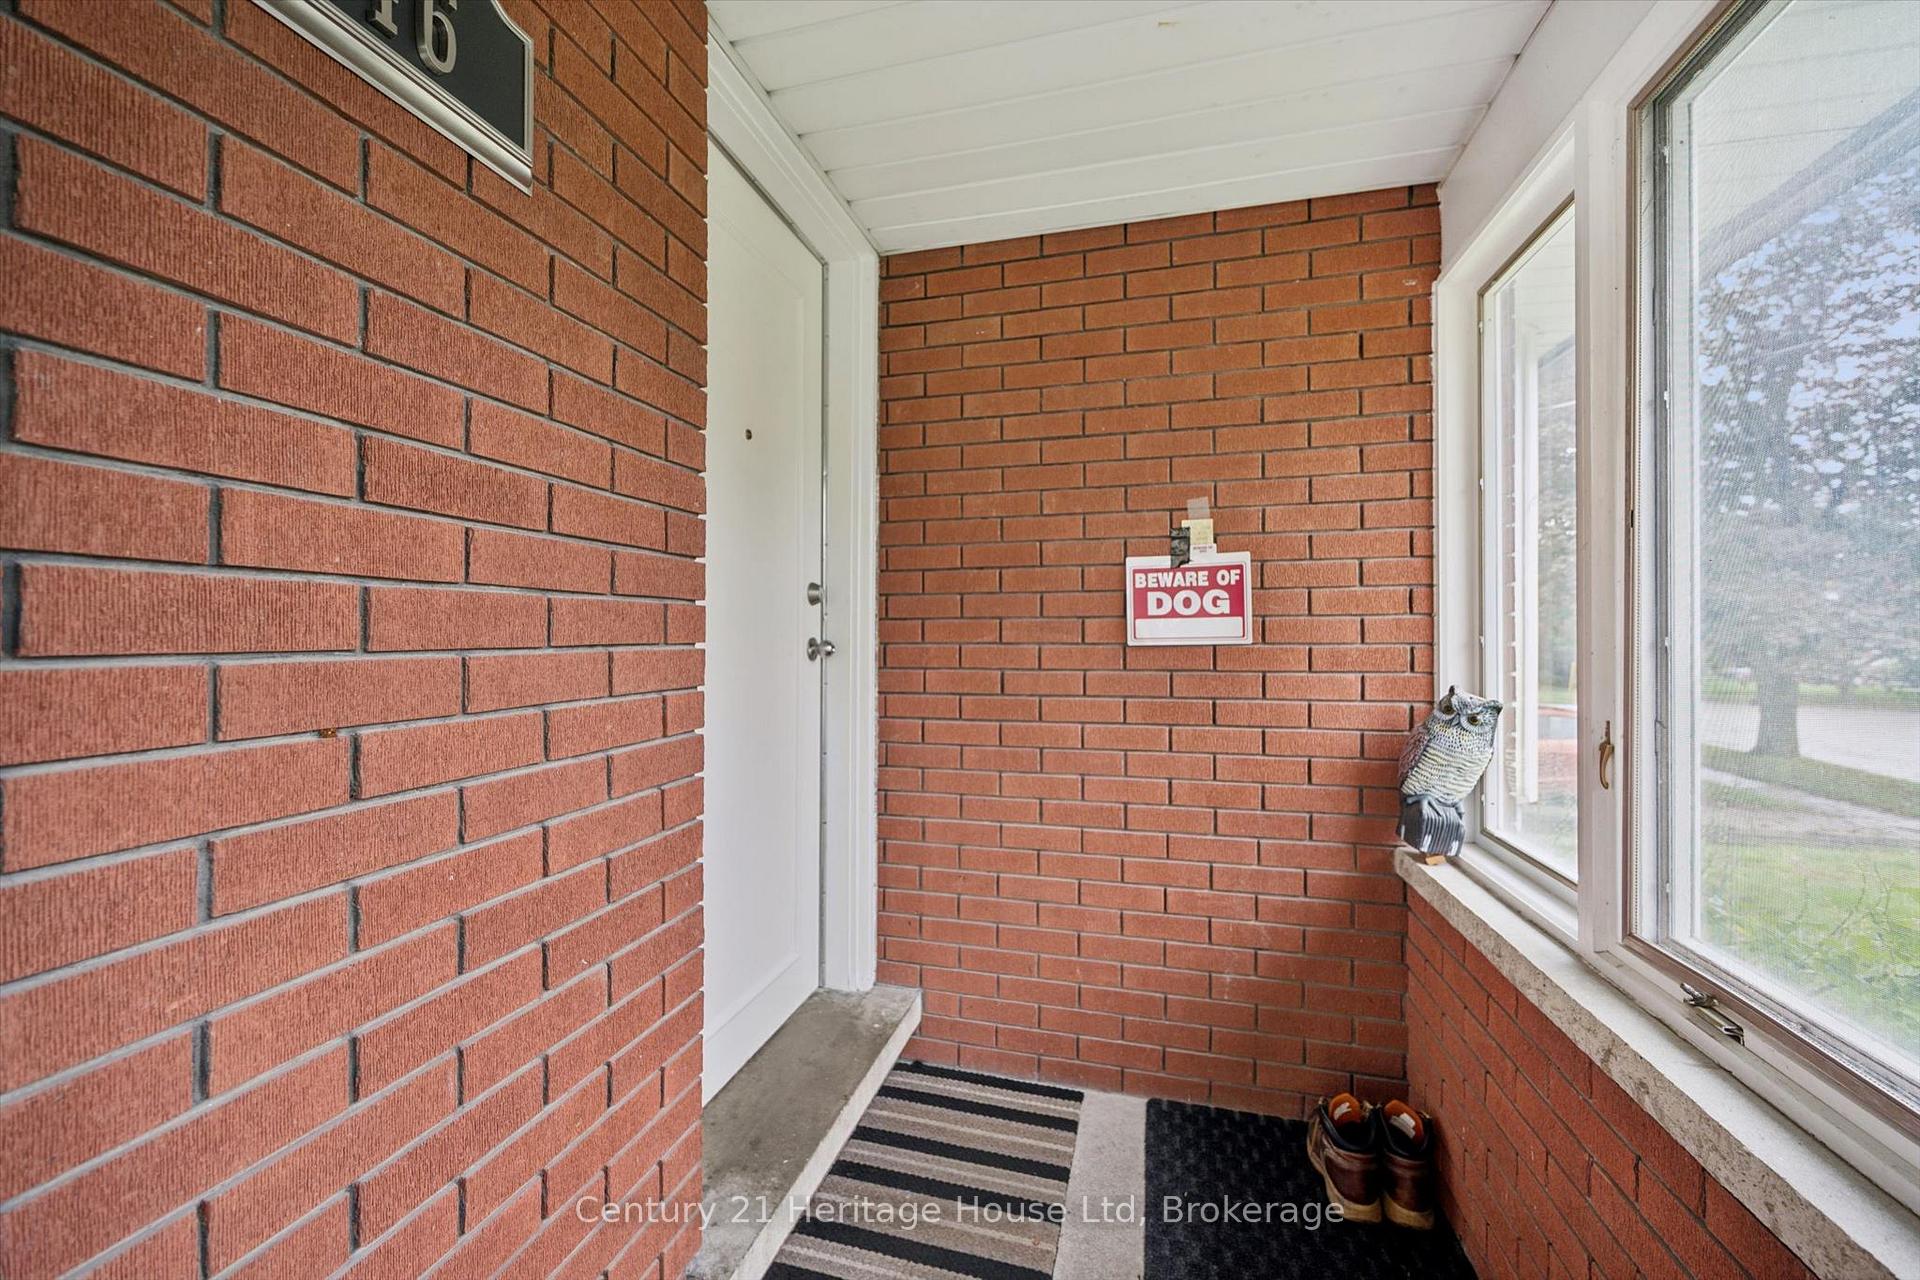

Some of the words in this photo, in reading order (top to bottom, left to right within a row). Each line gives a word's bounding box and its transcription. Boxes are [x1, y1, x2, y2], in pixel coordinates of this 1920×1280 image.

[369, 0, 457, 74] 6
[1134, 571, 1209, 588] BEWARE
[1216, 569, 1240, 586] OF
[1147, 589, 1230, 616] DOG
